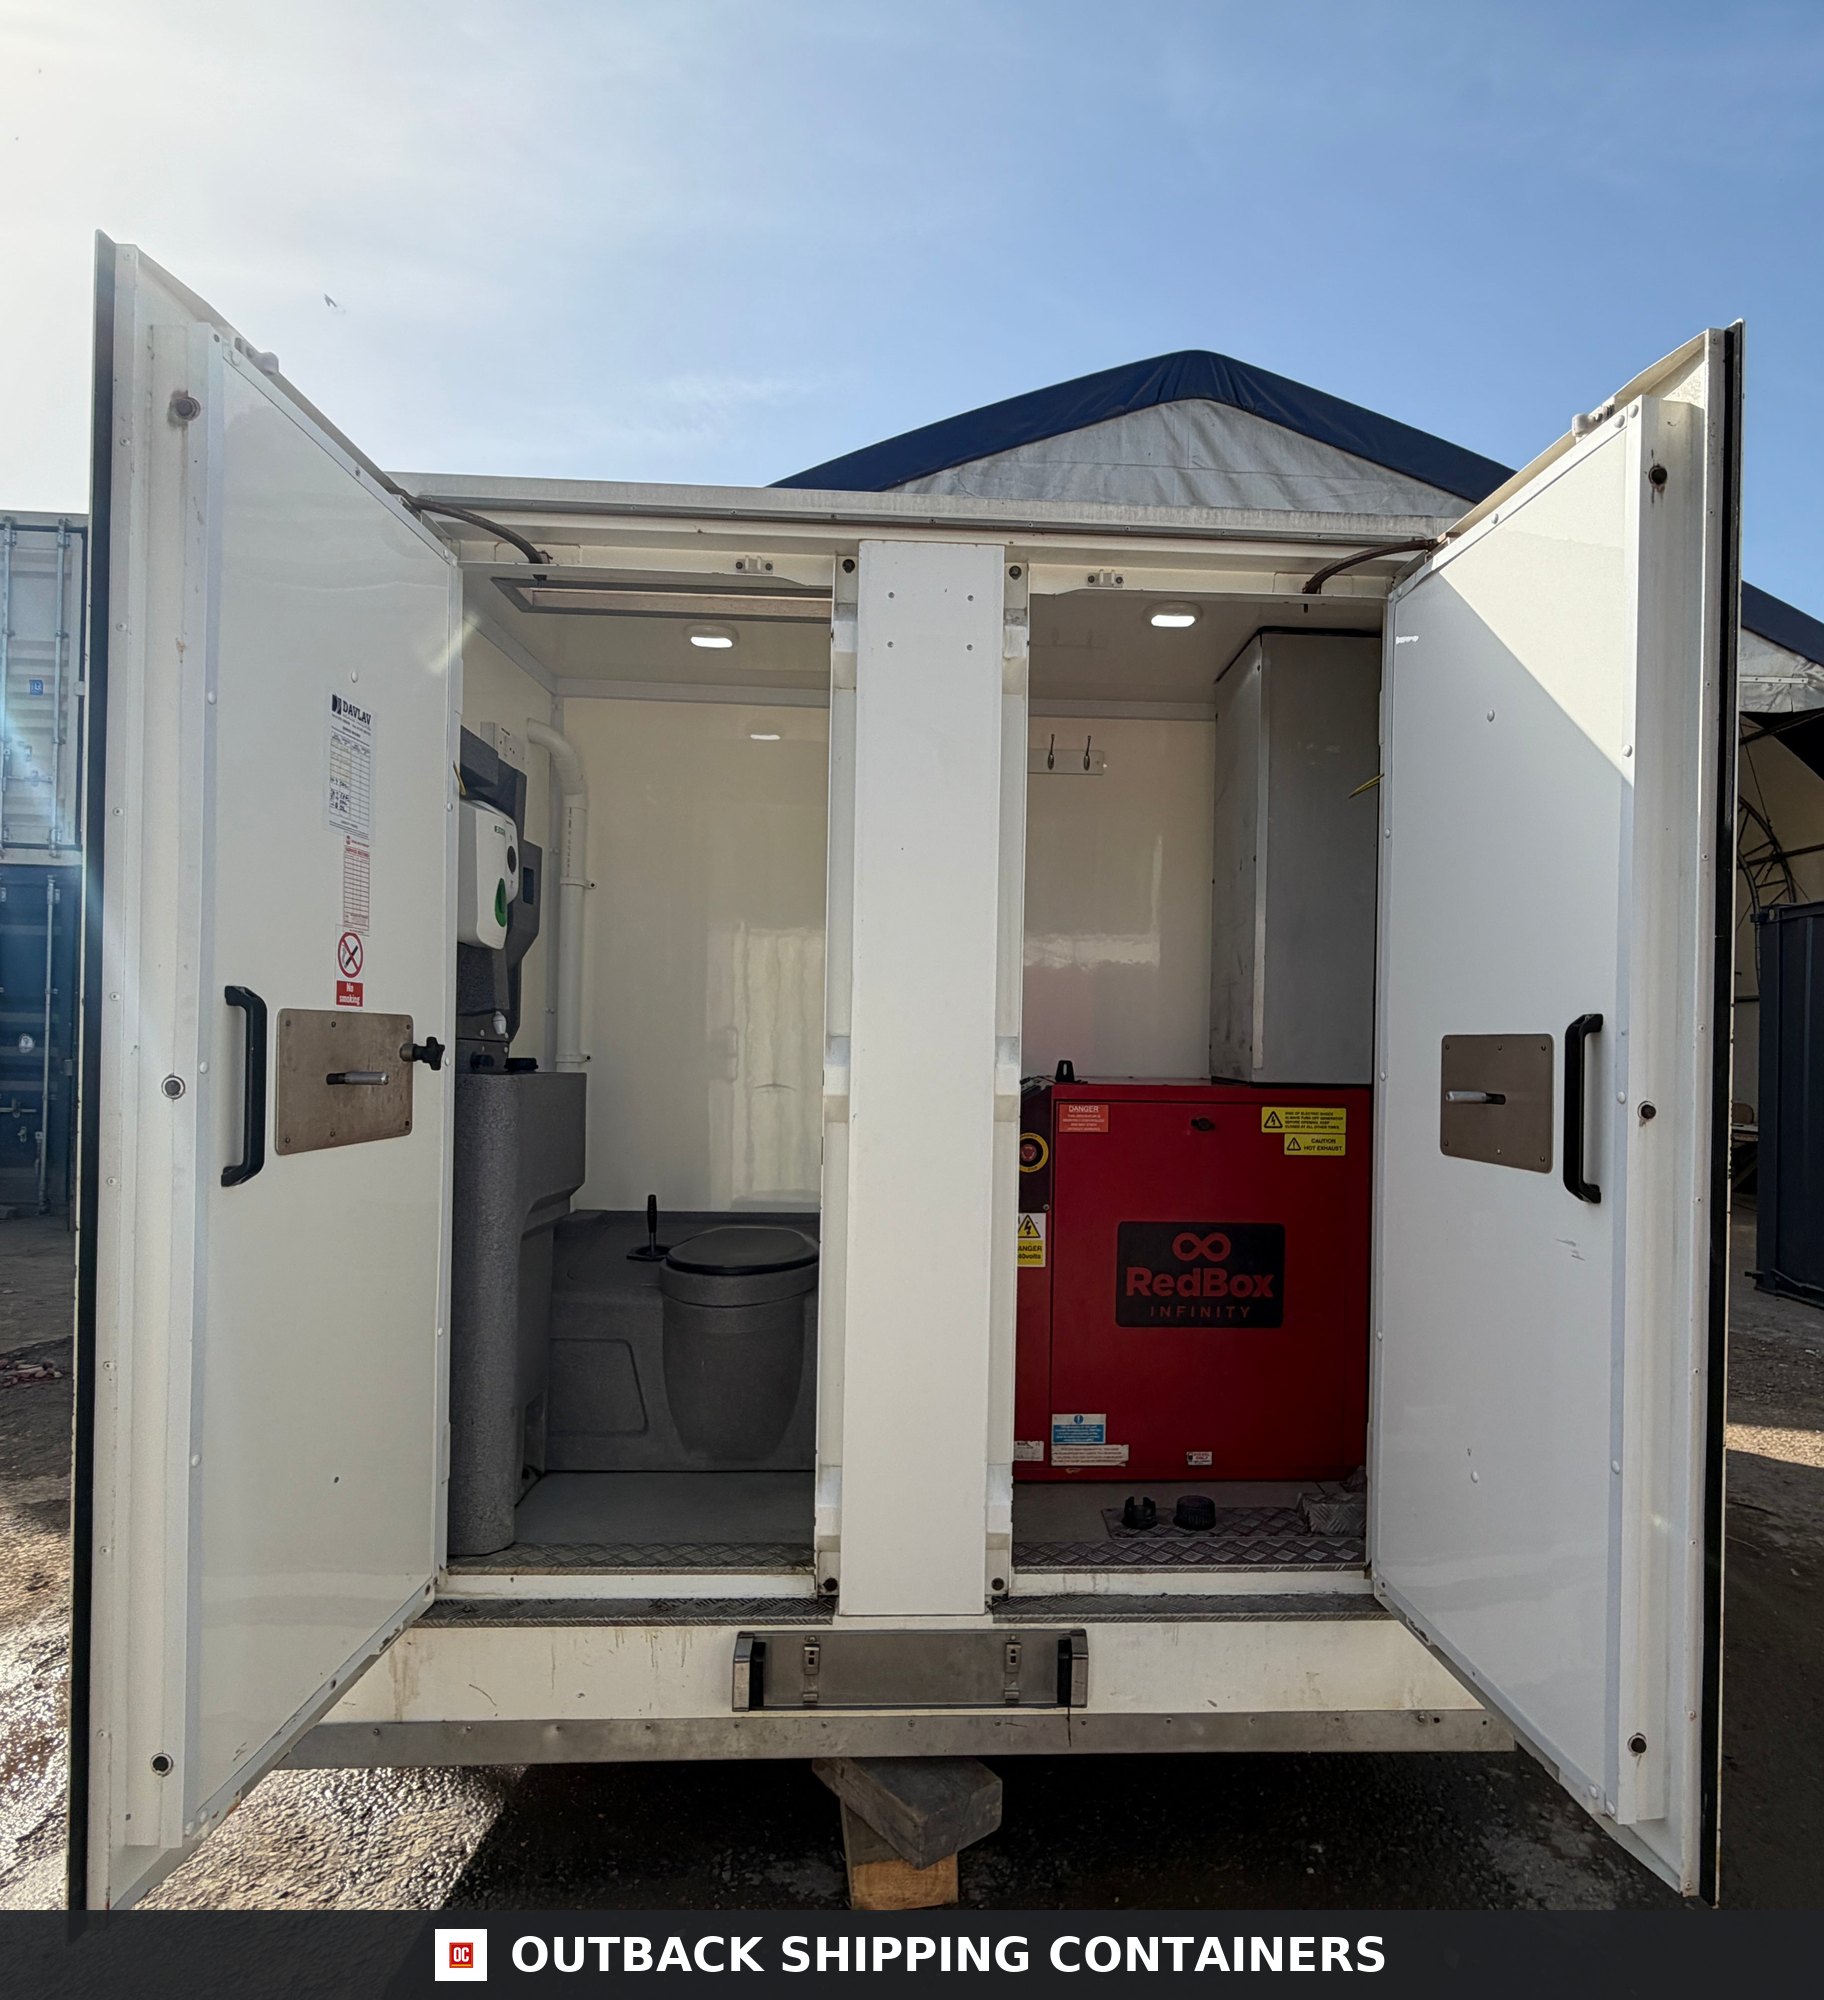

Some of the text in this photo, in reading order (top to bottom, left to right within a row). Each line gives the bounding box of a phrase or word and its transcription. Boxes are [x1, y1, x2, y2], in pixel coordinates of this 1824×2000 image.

[346, 982, 354, 993] No
[339, 994, 361, 1006] smoking
[1068, 1105, 1099, 1113] DANGER
[1126, 1266, 1274, 1298] RedBox
[1150, 1305, 1251, 1319] INFINITY
